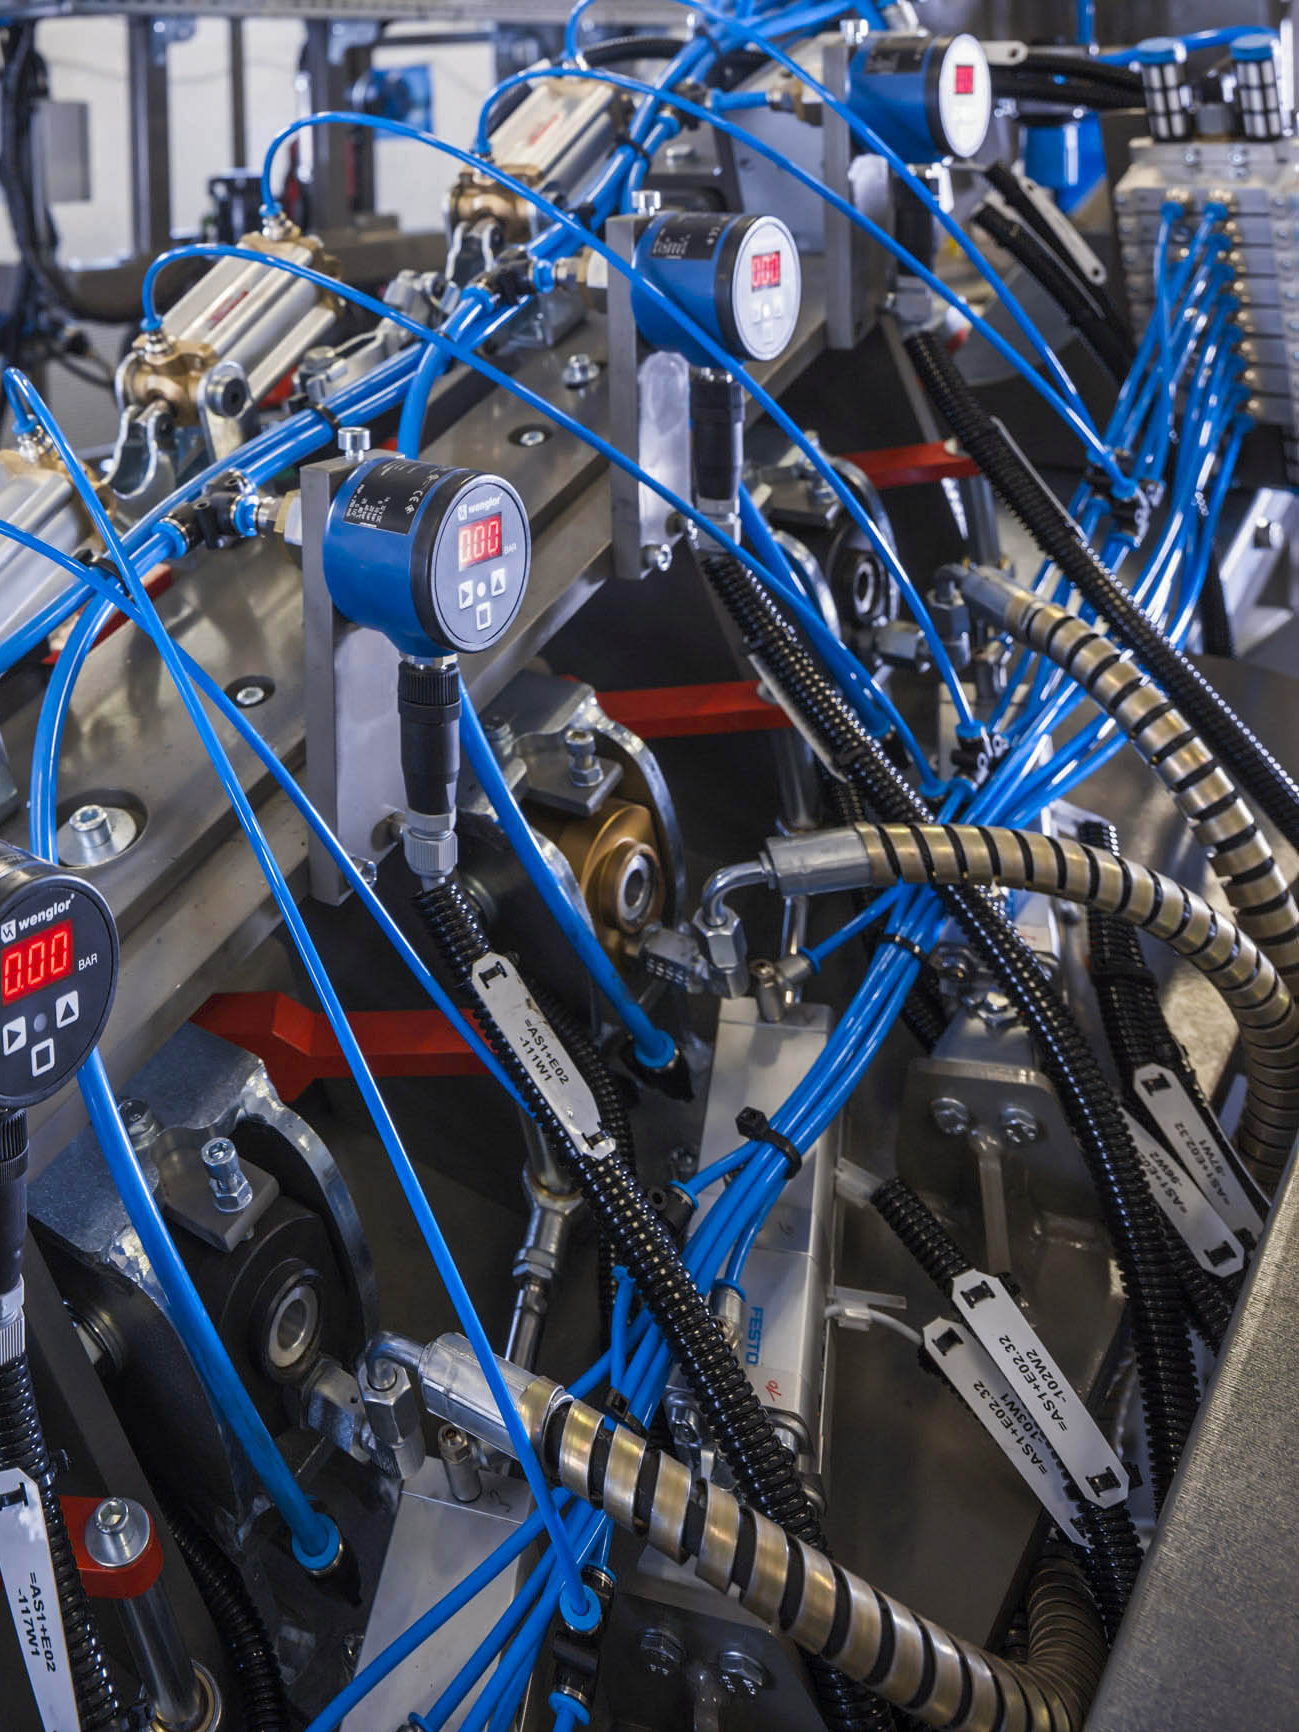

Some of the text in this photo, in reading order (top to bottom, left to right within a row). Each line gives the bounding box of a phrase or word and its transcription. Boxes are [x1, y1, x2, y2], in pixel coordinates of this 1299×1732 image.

[468, 496, 502, 513] wenglor
[504, 542, 517, 556] BAR
[18, 898, 72, 932] wenglor
[78, 954, 98, 972] BAR
[520, 1036, 553, 1082] -111W1
[524, 1018, 570, 1085] =AS1+E02
[746, 1306, 764, 1366] FESTO
[999, 1334, 1068, 1432] =AS1+E02.32
[1026, 1348, 1068, 1402] -102W2
[973, 1380, 1047, 1476] =AS1+E02.32
[1000, 1392, 1044, 1443] -103W1
[17, 1588, 40, 1656] -117W1
[29, 1572, 56, 1672] =AS1+E02
